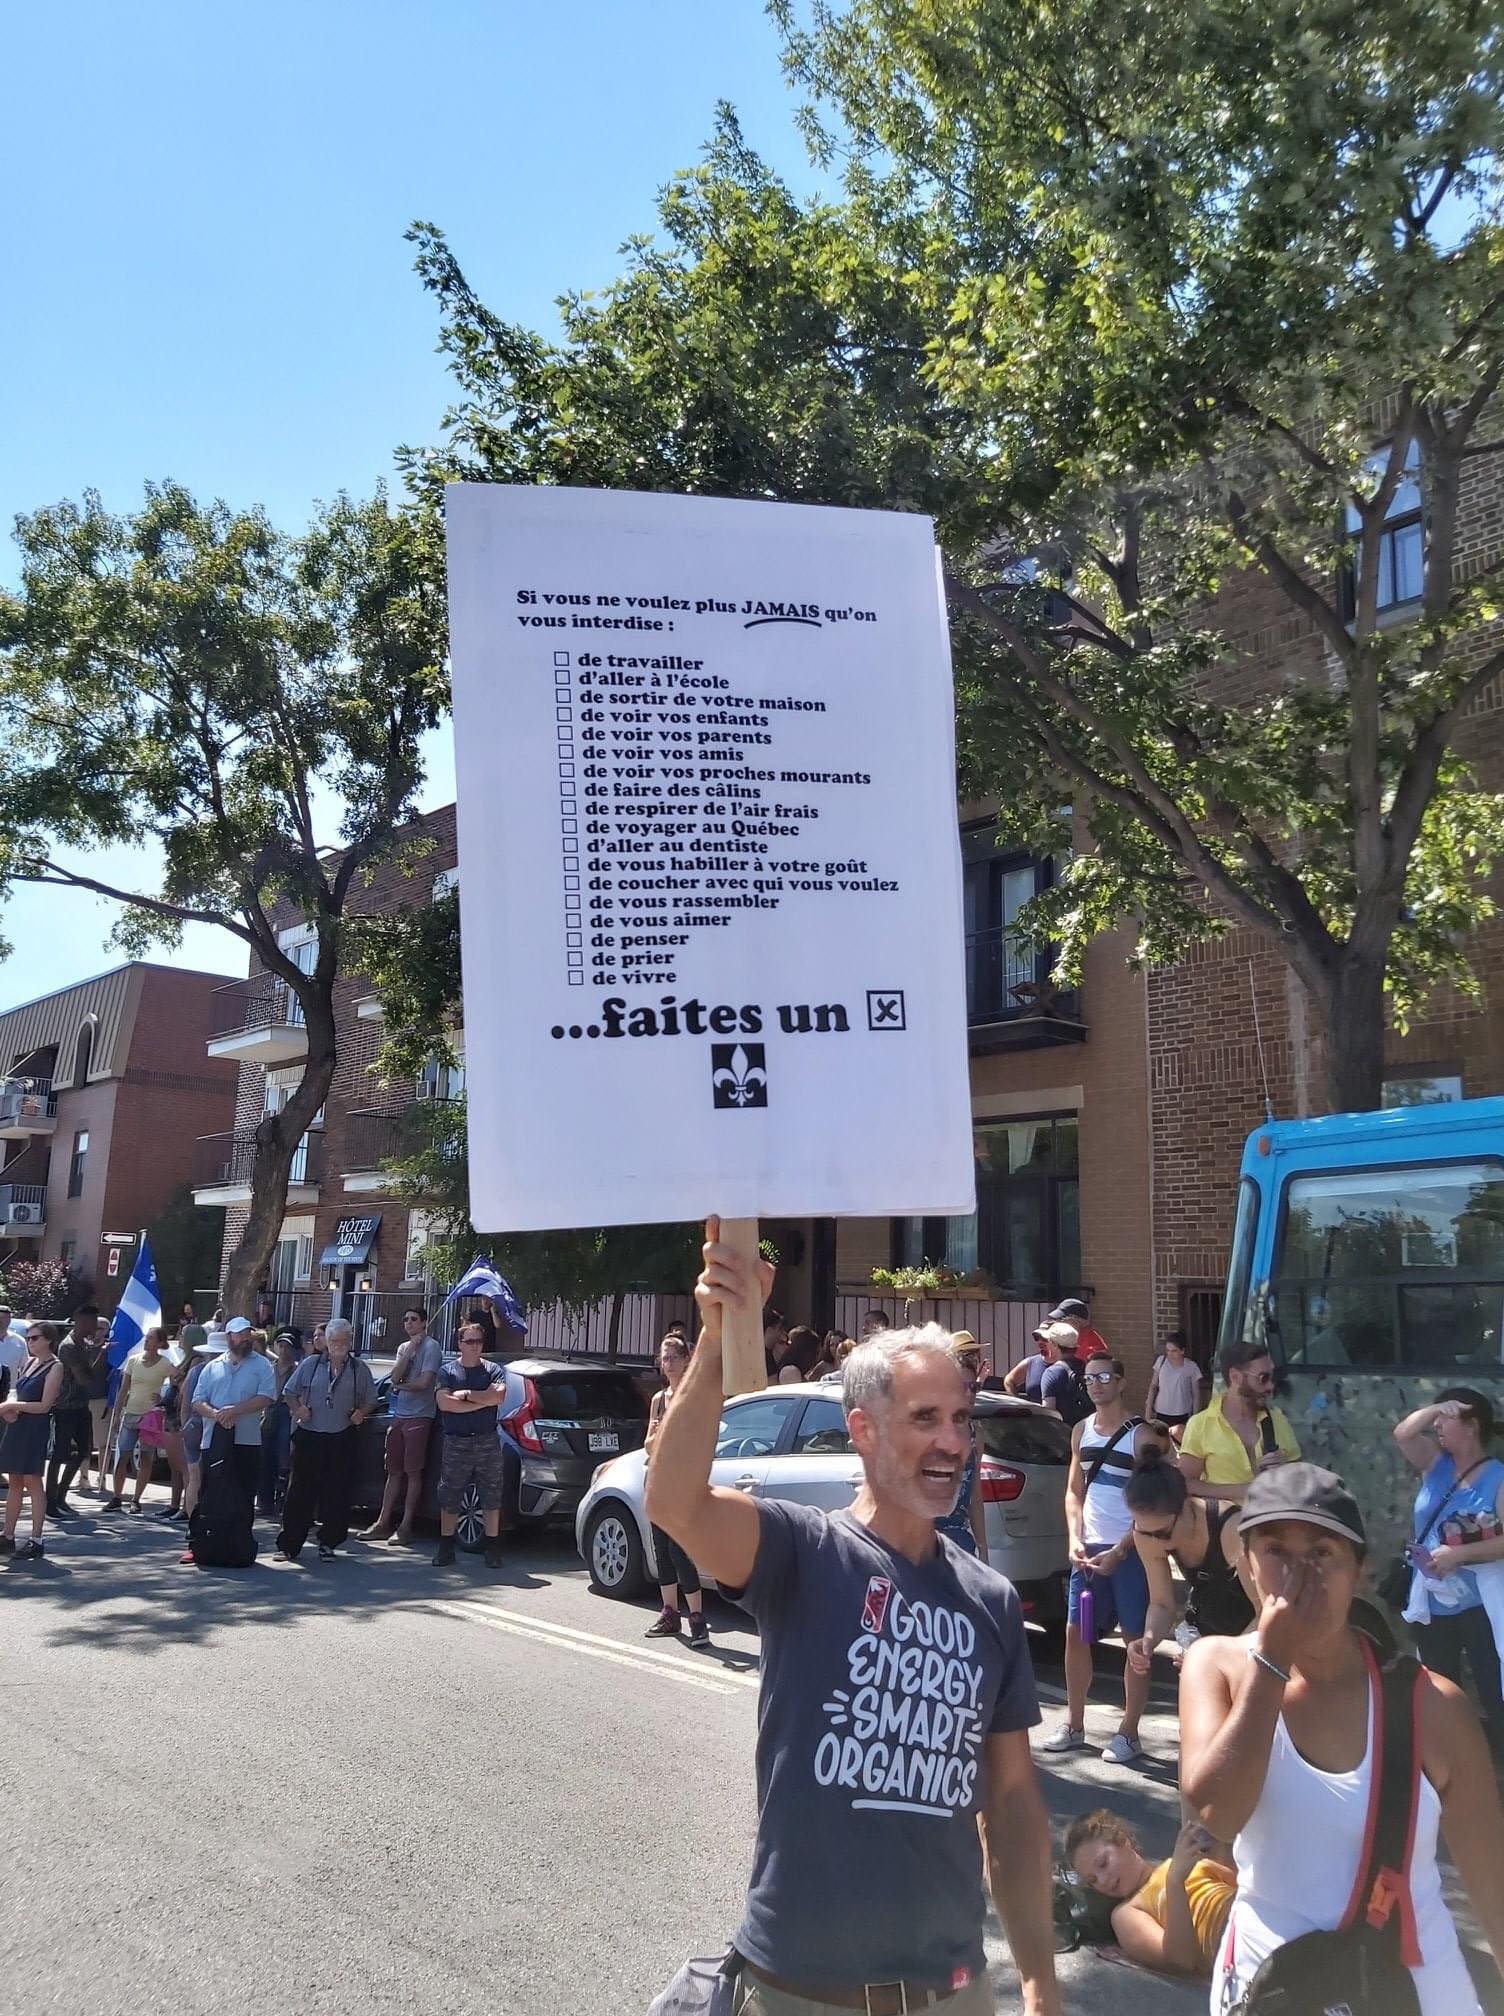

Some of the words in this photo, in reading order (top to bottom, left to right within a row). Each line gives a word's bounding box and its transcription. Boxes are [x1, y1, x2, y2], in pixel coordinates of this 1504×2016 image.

[516, 589, 538, 605] Si
[541, 593, 592, 606] vous
[595, 595, 621, 607] ne
[623, 595, 692, 611] voulez
[694, 597, 737, 615] plus
[740, 599, 821, 619] JAMAIS
[824, 606, 878, 623] qu'on
[516, 615, 568, 628] vous
[570, 613, 664, 632] interdise
[577, 652, 603, 668] de
[606, 654, 705, 671] travailler
[578, 670, 646, 687] d'aller
[650, 671, 663, 688] à
[665, 673, 730, 690] l'école
[579, 688, 605, 705] de
[608, 690, 669, 706] sortir
[672, 691, 697, 707] de
[700, 694, 755, 709] votre
[758, 696, 827, 713] maison
[580, 707, 605, 723] de
[608, 708, 653, 724] voir
[656, 712, 692, 725] vos
[695, 710, 769, 728] enfants
[580, 726, 607, 742] de
[609, 726, 654, 742] voir
[657, 730, 693, 743] vos
[696, 731, 773, 746] parents
[582, 744, 607, 760] de
[610, 745, 655, 761] voir
[658, 748, 694, 761] vos
[697, 746, 745, 762] amis
[582, 763, 608, 779] de
[611, 763, 656, 779] voir
[659, 767, 695, 779] vos
[698, 765, 776, 783] proches
[779, 770, 872, 785] mourants
[583, 782, 609, 797] de
[612, 782, 663, 798] faire
[666, 782, 701, 798] des
[704, 782, 762, 799] câlins
[584, 800, 610, 816] de
[613, 800, 699, 819] respirer
[702, 800, 727, 816] de
[730, 801, 771, 818] l'air
[774, 803, 820, 820] frais
[585, 819, 611, 835] de
[614, 822, 698, 838] voyager
[701, 822, 727, 834] au
[730, 819, 800, 838] Québec
[586, 837, 655, 854] d'aller
[658, 841, 685, 853] au
[688, 837, 769, 855] dentiste
[587, 856, 613, 872] de
[615, 859, 666, 872] vous
[669, 855, 750, 872] habiller
[753, 856, 764, 873] à
[767, 859, 821, 874] votre
[824, 858, 868, 877] goût
[587, 875, 614, 891] de
[617, 874, 701, 891] coucher
[704, 878, 749, 890] avec
[752, 876, 785, 894] qui
[787, 879, 834, 891] vous
[836, 877, 900, 892] voulez
[588, 894, 614, 910] de
[617, 897, 668, 909] vous
[671, 893, 780, 909] rassembler
[589, 913, 615, 929] de
[618, 915, 669, 929] vous
[672, 911, 732, 927] aimer
[590, 932, 616, 948] de
[619, 934, 690, 951] penser
[590, 951, 617, 967] de
[620, 950, 676, 970] prier
[591, 970, 617, 986] de
[620, 969, 678, 985] vivre
[775, 1003, 851, 1034] un
[336, 1217, 372, 1233] HÔTEL
[336, 1232, 365, 1245] MINI
[889, 1591, 976, 1658] GOOD
[847, 1634, 984, 1712] ENERGY.
[851, 1686, 978, 1755] SMART
[814, 1732, 978, 1808] ORGANICS
